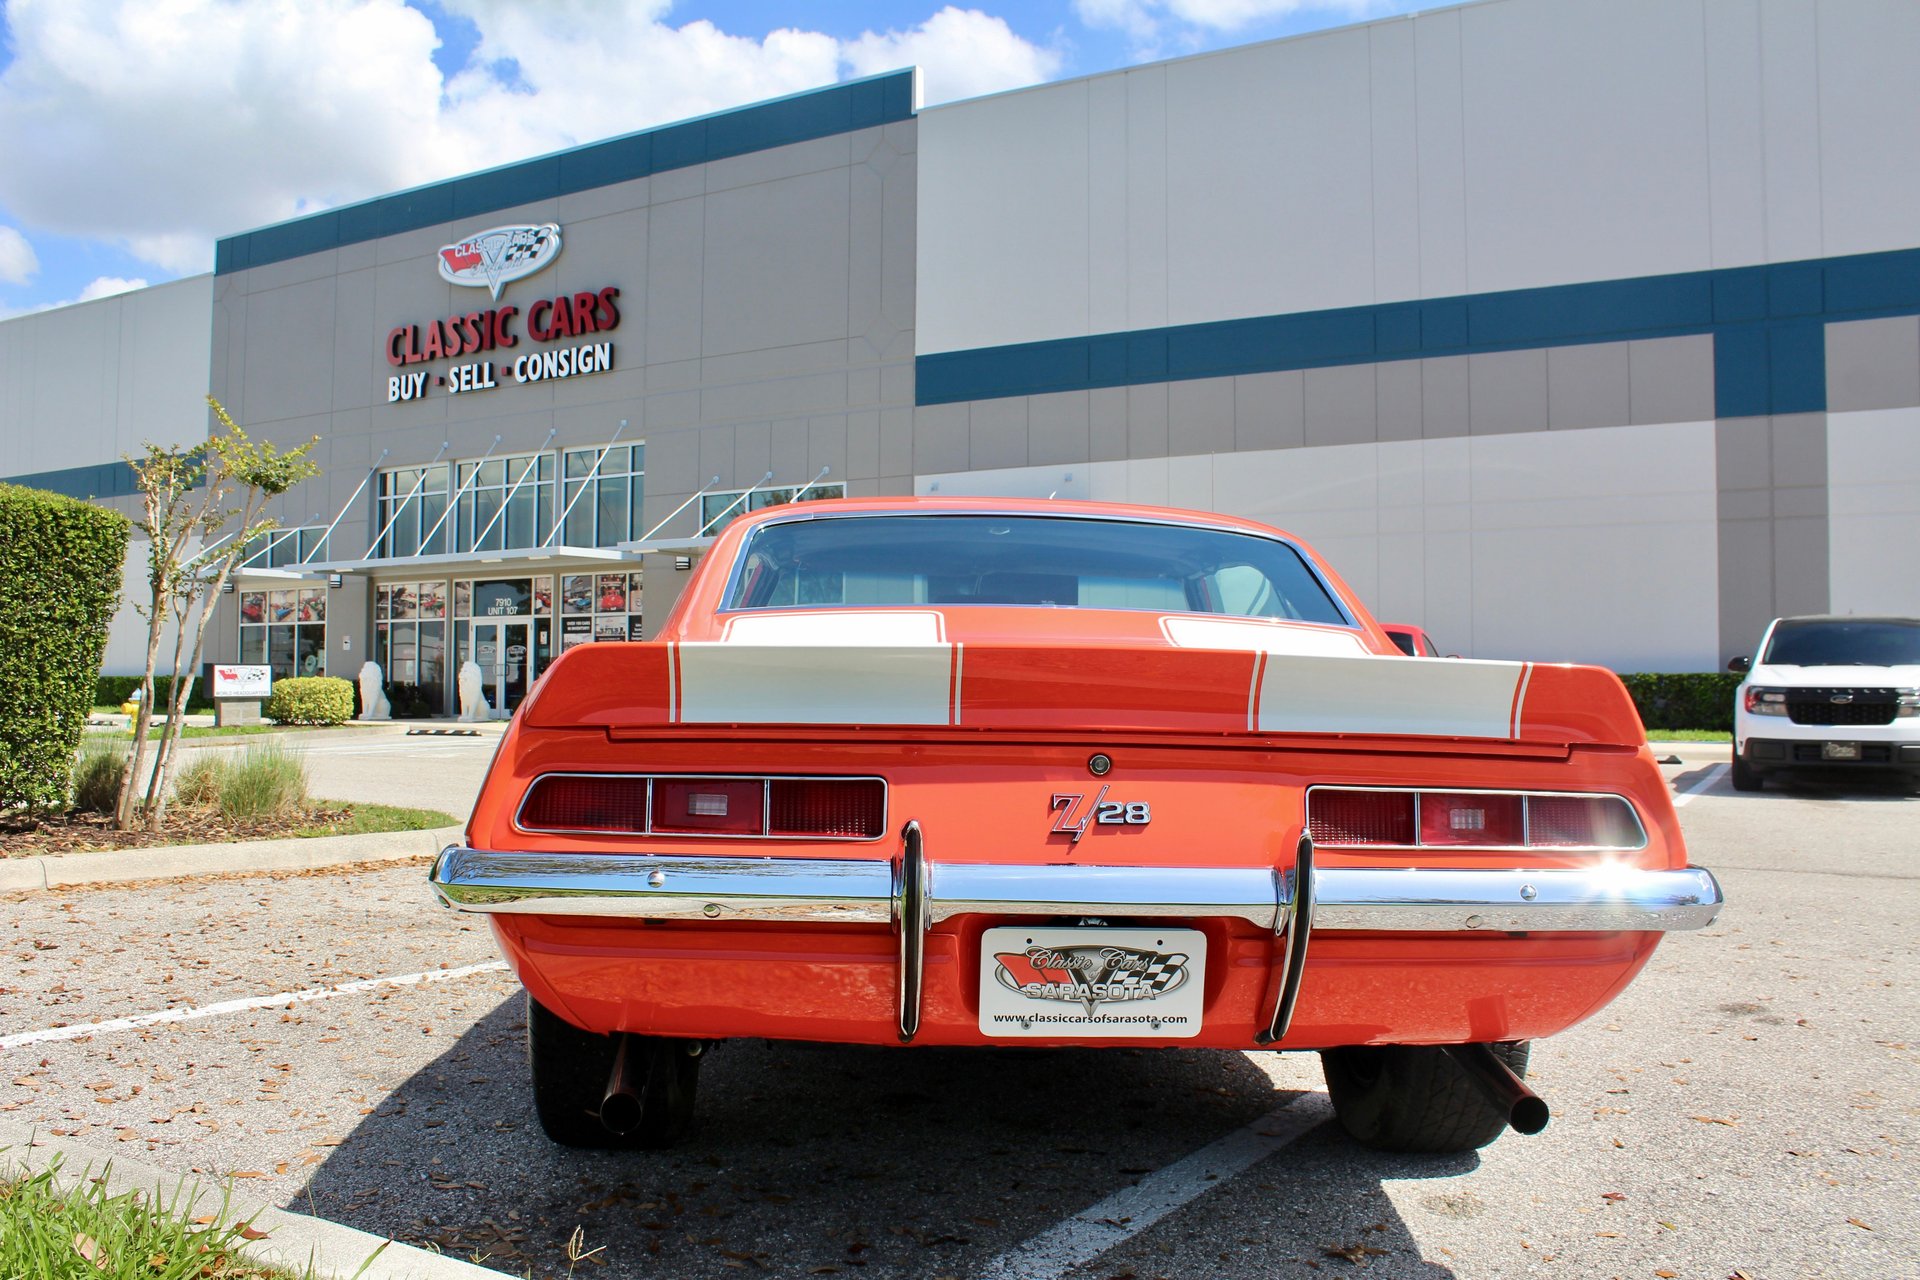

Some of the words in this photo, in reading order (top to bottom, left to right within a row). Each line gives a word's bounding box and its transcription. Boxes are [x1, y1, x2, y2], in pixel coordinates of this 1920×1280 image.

[386, 306, 517, 366] CLASSIC
[527, 287, 619, 342] CARS
[388, 372, 428, 402] BUY
[449, 362, 496, 393] SELL
[514, 342, 614, 383] CONSIGN
[487, 607, 504, 615] UNIT
[506, 606, 519, 615] 107
[495, 598, 512, 607] 7910
[1025, 946, 1094, 971] Classic
[1099, 947, 1149, 971] Cars
[1025, 982, 1156, 1001] SARASOTA
[993, 1012, 1188, 1025] www.classiccarsofsarasota.com
